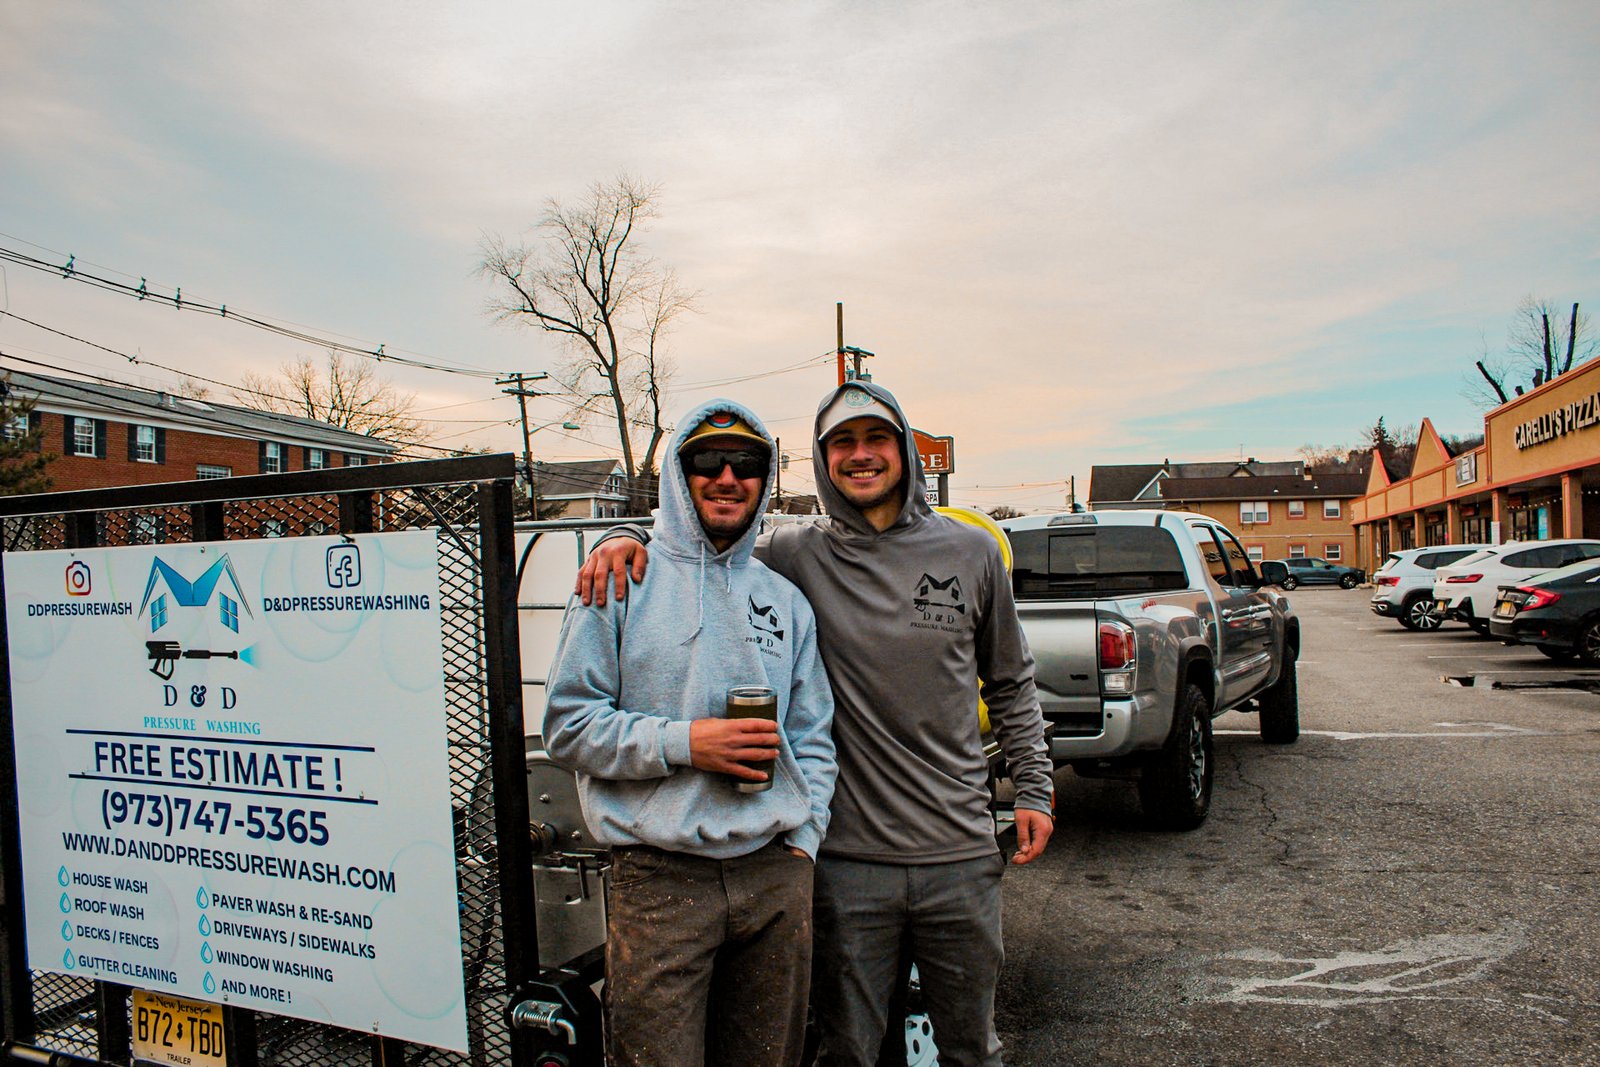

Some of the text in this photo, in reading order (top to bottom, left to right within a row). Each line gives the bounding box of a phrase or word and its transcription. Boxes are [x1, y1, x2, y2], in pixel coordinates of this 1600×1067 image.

[1514, 392, 1600, 449] CARELLI'S PIZZA
[28, 602, 132, 616] DDPRESSUREWASH
[263, 595, 429, 612] D&DPRESSUREWASHING
[164, 685, 236, 709] D & D
[144, 717, 260, 734] PRESSURE WASHING
[95, 742, 162, 776] FREE
[171, 747, 324, 790] ESTIMATE
[101, 789, 329, 846] (973)747-5365
[62, 832, 396, 892] WWW.DANDDPRESSUREWASH.COM
[73, 872, 147, 894] HOUSE WASH
[75, 898, 144, 920] ROOF WASH
[212, 894, 372, 930] PAVER WASH & RE-SAND
[77, 925, 110, 941] DECKS
[120, 932, 159, 950] FENCES
[214, 920, 287, 944] DRIVEWAYS
[299, 934, 375, 959] SIDEWALKS
[79, 955, 177, 984] GUTTER CLEANING
[216, 950, 333, 982] WINDOW WASHING
[222, 980, 246, 994] AND
[250, 984, 285, 1002] MORE
[156, 996, 203, 1016] New Jersey
[138, 1007, 222, 1057] B72 TBD
[167, 1053, 191, 1065] TRAILER
